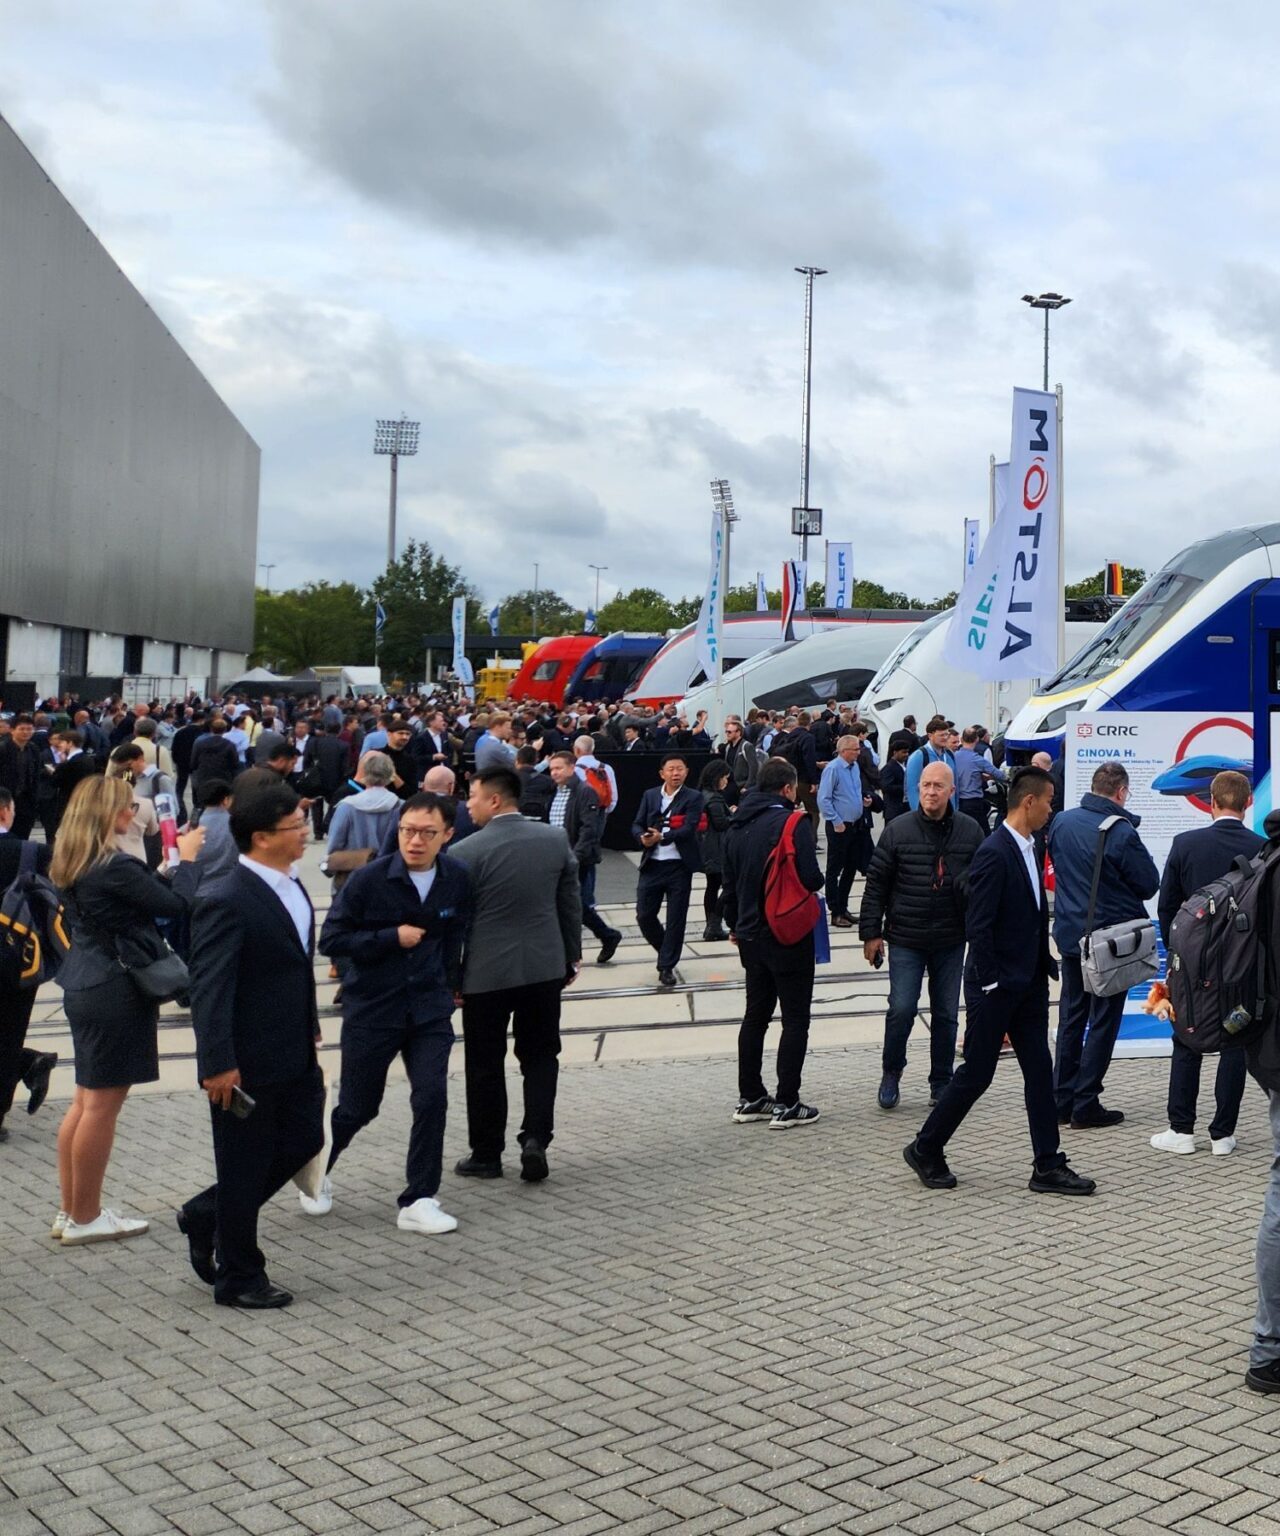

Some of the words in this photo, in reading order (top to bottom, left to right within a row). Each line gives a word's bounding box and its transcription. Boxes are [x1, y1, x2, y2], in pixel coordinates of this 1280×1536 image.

[794, 510, 809, 532] P
[807, 521, 820, 533] 18
[1097, 726, 1138, 736] CRRC
[1077, 749, 1120, 757] CINOVA
